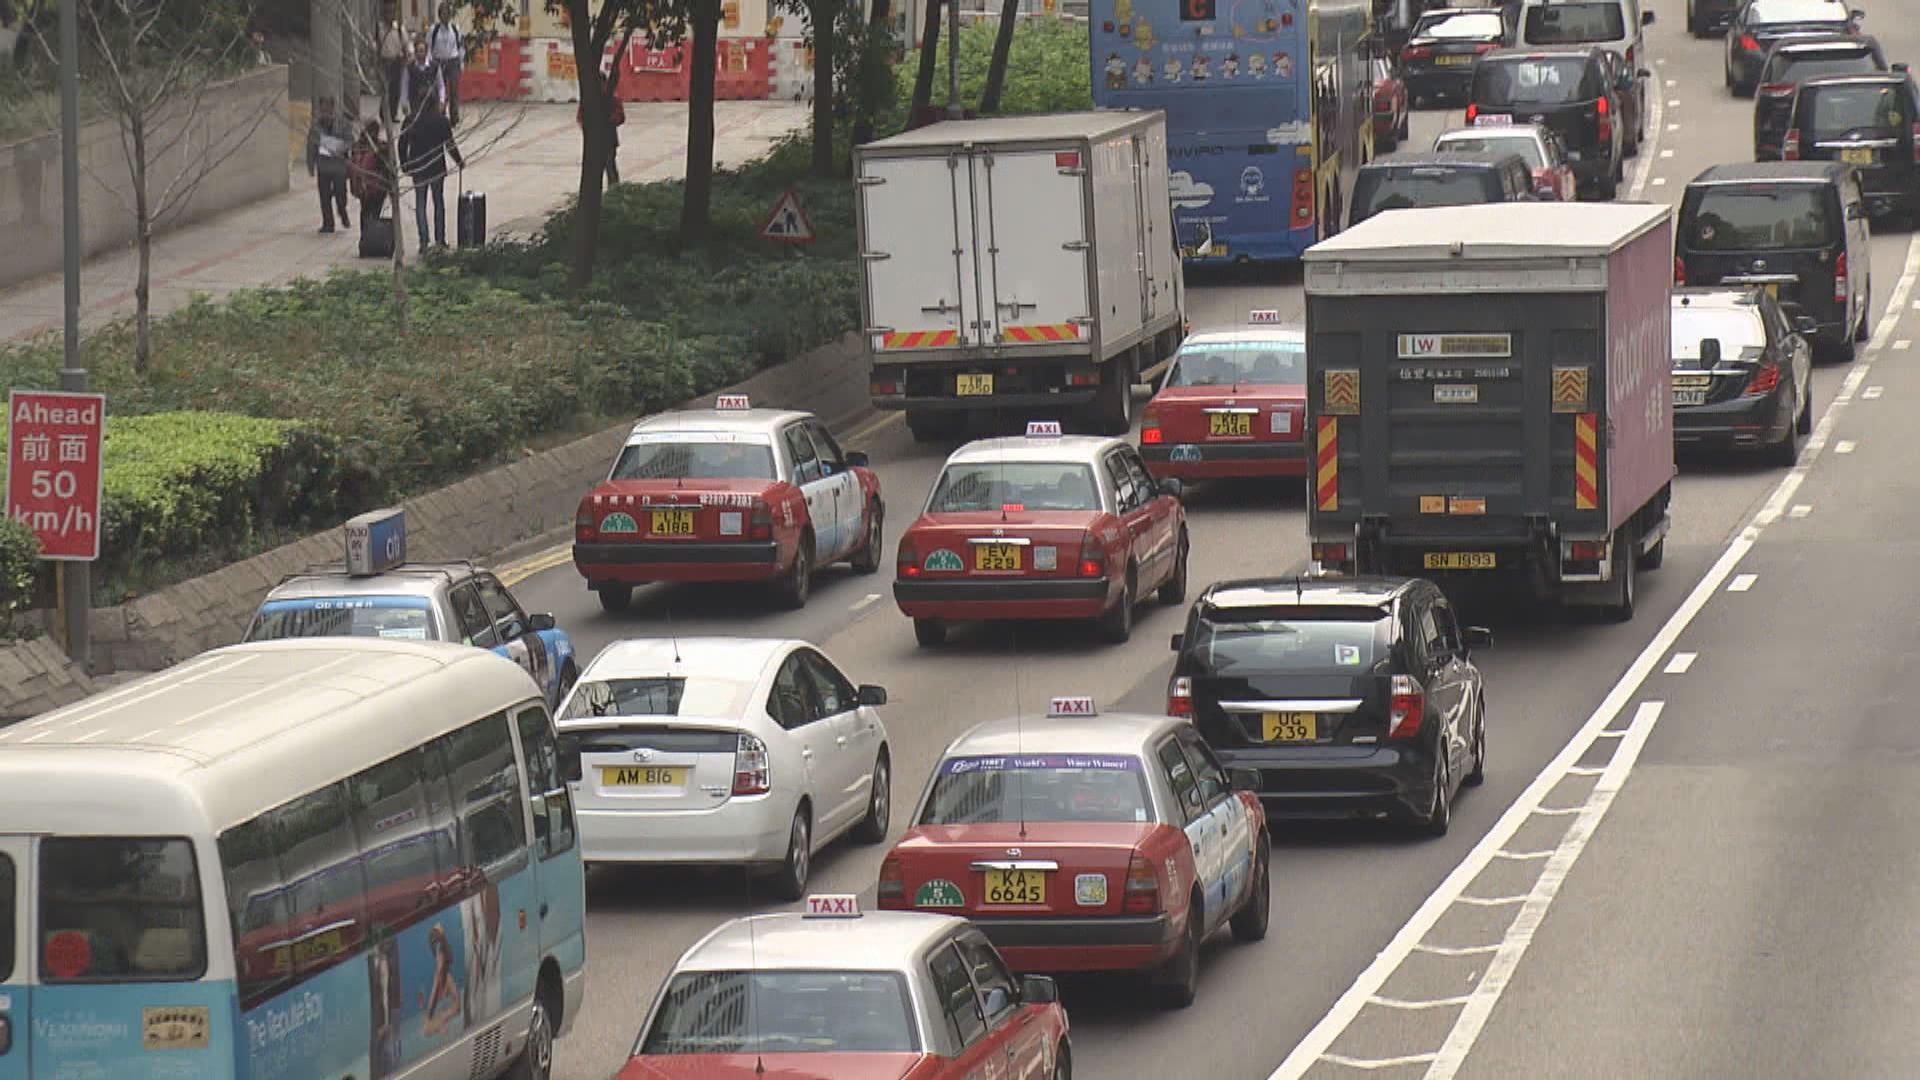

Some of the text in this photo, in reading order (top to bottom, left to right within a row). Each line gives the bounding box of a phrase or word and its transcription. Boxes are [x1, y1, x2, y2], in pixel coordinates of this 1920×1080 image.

[1252, 311, 1277, 321] TAXI
[718, 398, 746, 408] TAXI
[15, 401, 97, 425] Ahead
[1029, 423, 1058, 433] TAXI
[20, 433, 88, 463] 前面
[31, 469, 77, 499] 50
[15, 503, 92, 538] km/h
[987, 546, 1009, 557] EV
[1430, 553, 1449, 566] SN
[1339, 647, 1355, 661] P
[1053, 700, 1090, 713] TAXI
[1278, 711, 1302, 726] UG
[1271, 725, 1308, 741] 239
[616, 769, 673, 785] AM 816
[1003, 870, 1027, 886] KA
[933, 888, 943, 898] 5
[990, 886, 1041, 902] 6645
[809, 898, 853, 913] TAXI
